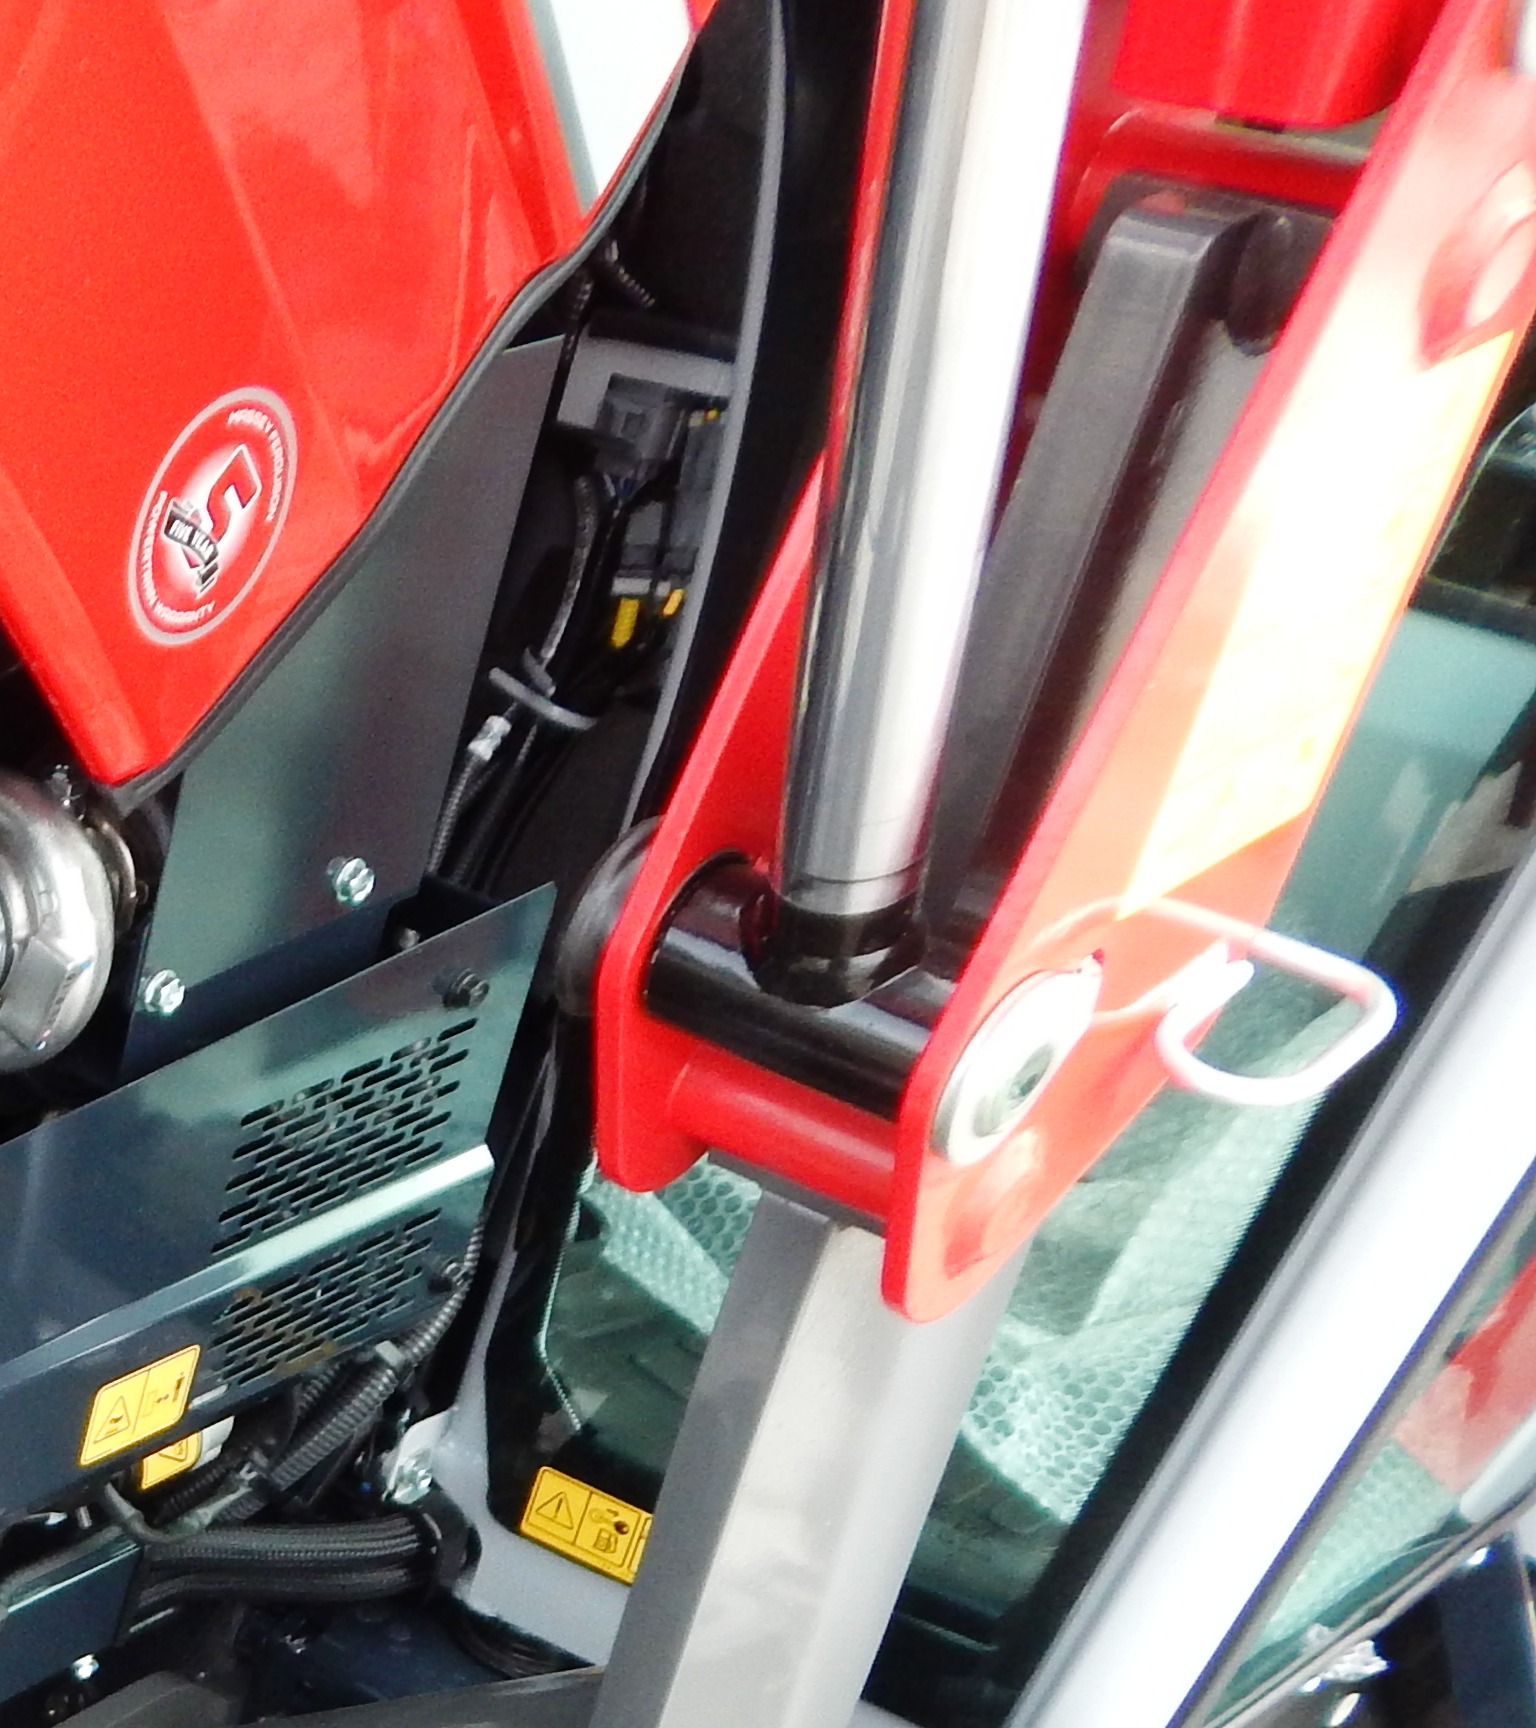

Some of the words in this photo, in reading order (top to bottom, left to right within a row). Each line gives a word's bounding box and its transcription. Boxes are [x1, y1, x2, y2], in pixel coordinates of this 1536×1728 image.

[228, 408, 273, 432] MASSEY
[265, 430, 285, 522] FERGUSON
[140, 490, 169, 606] POWERTRAIN
[170, 519, 193, 542] FIVE
[192, 530, 215, 562] YEAR
[154, 600, 215, 624] WARRANTY
